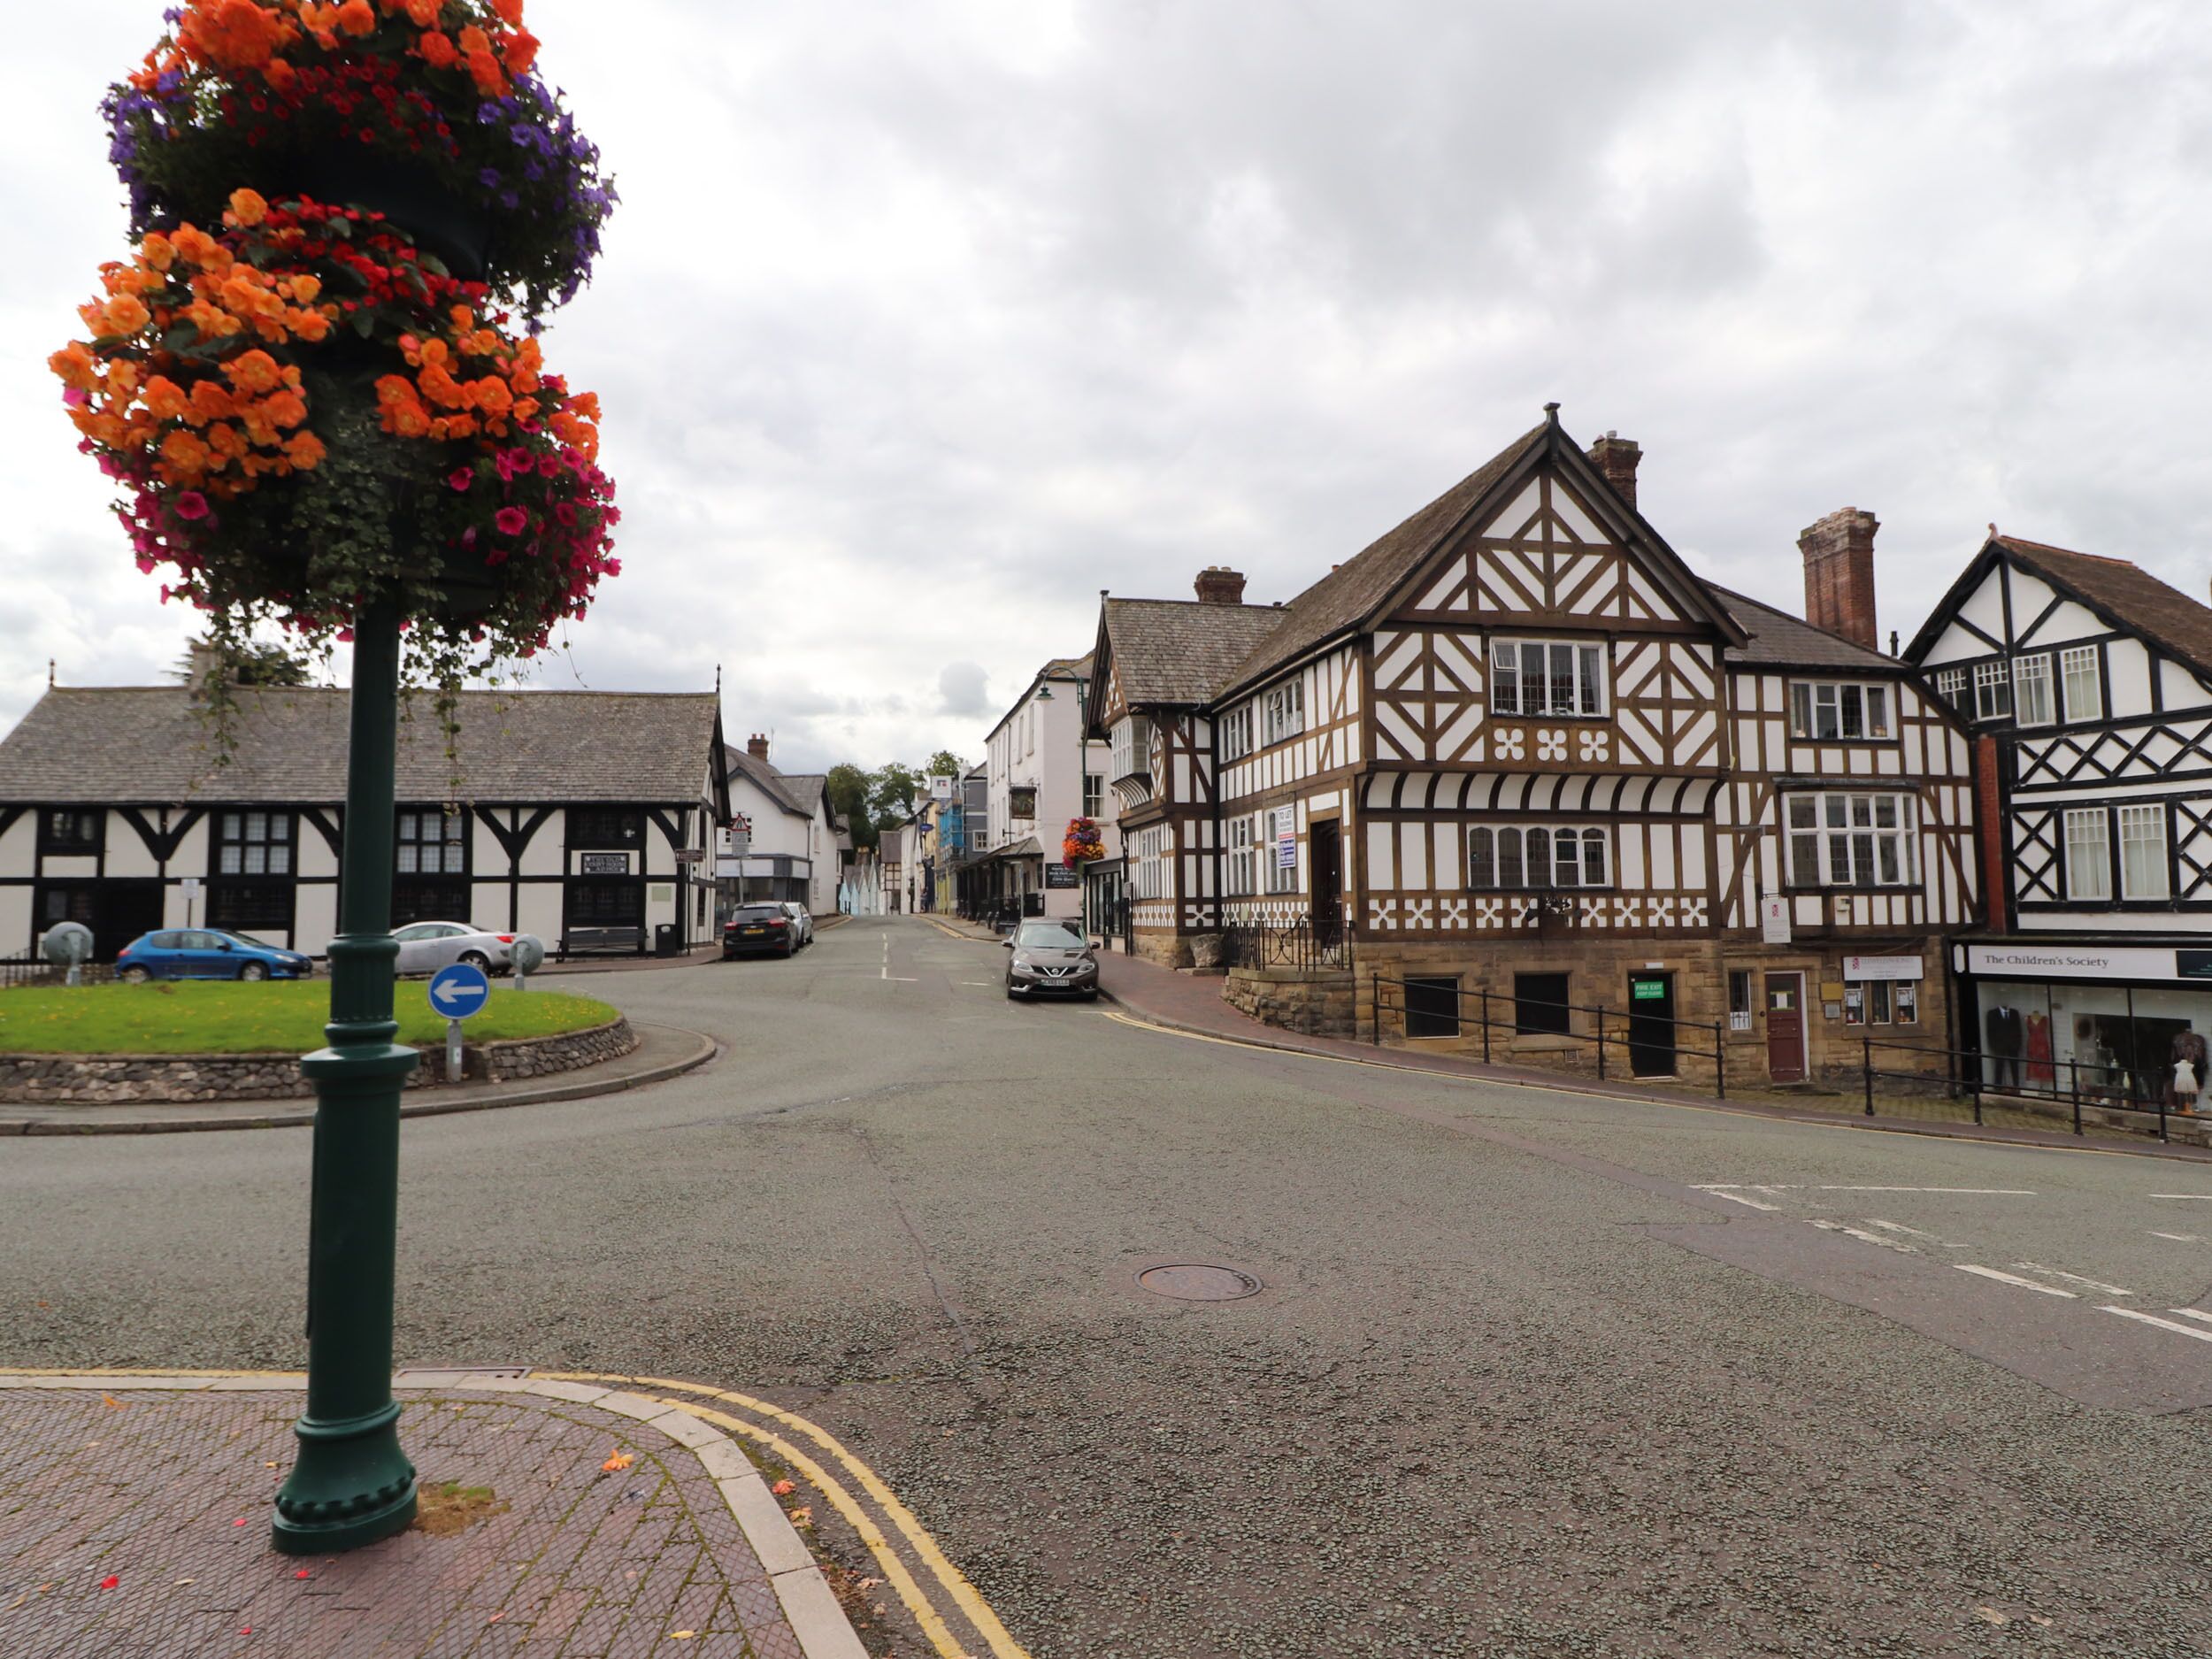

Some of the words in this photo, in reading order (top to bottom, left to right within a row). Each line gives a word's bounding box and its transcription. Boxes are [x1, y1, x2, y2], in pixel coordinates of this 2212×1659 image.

[1985, 955, 2005, 964] The
[2007, 955, 2063, 965] Children's
[2066, 956, 2109, 969] Society
